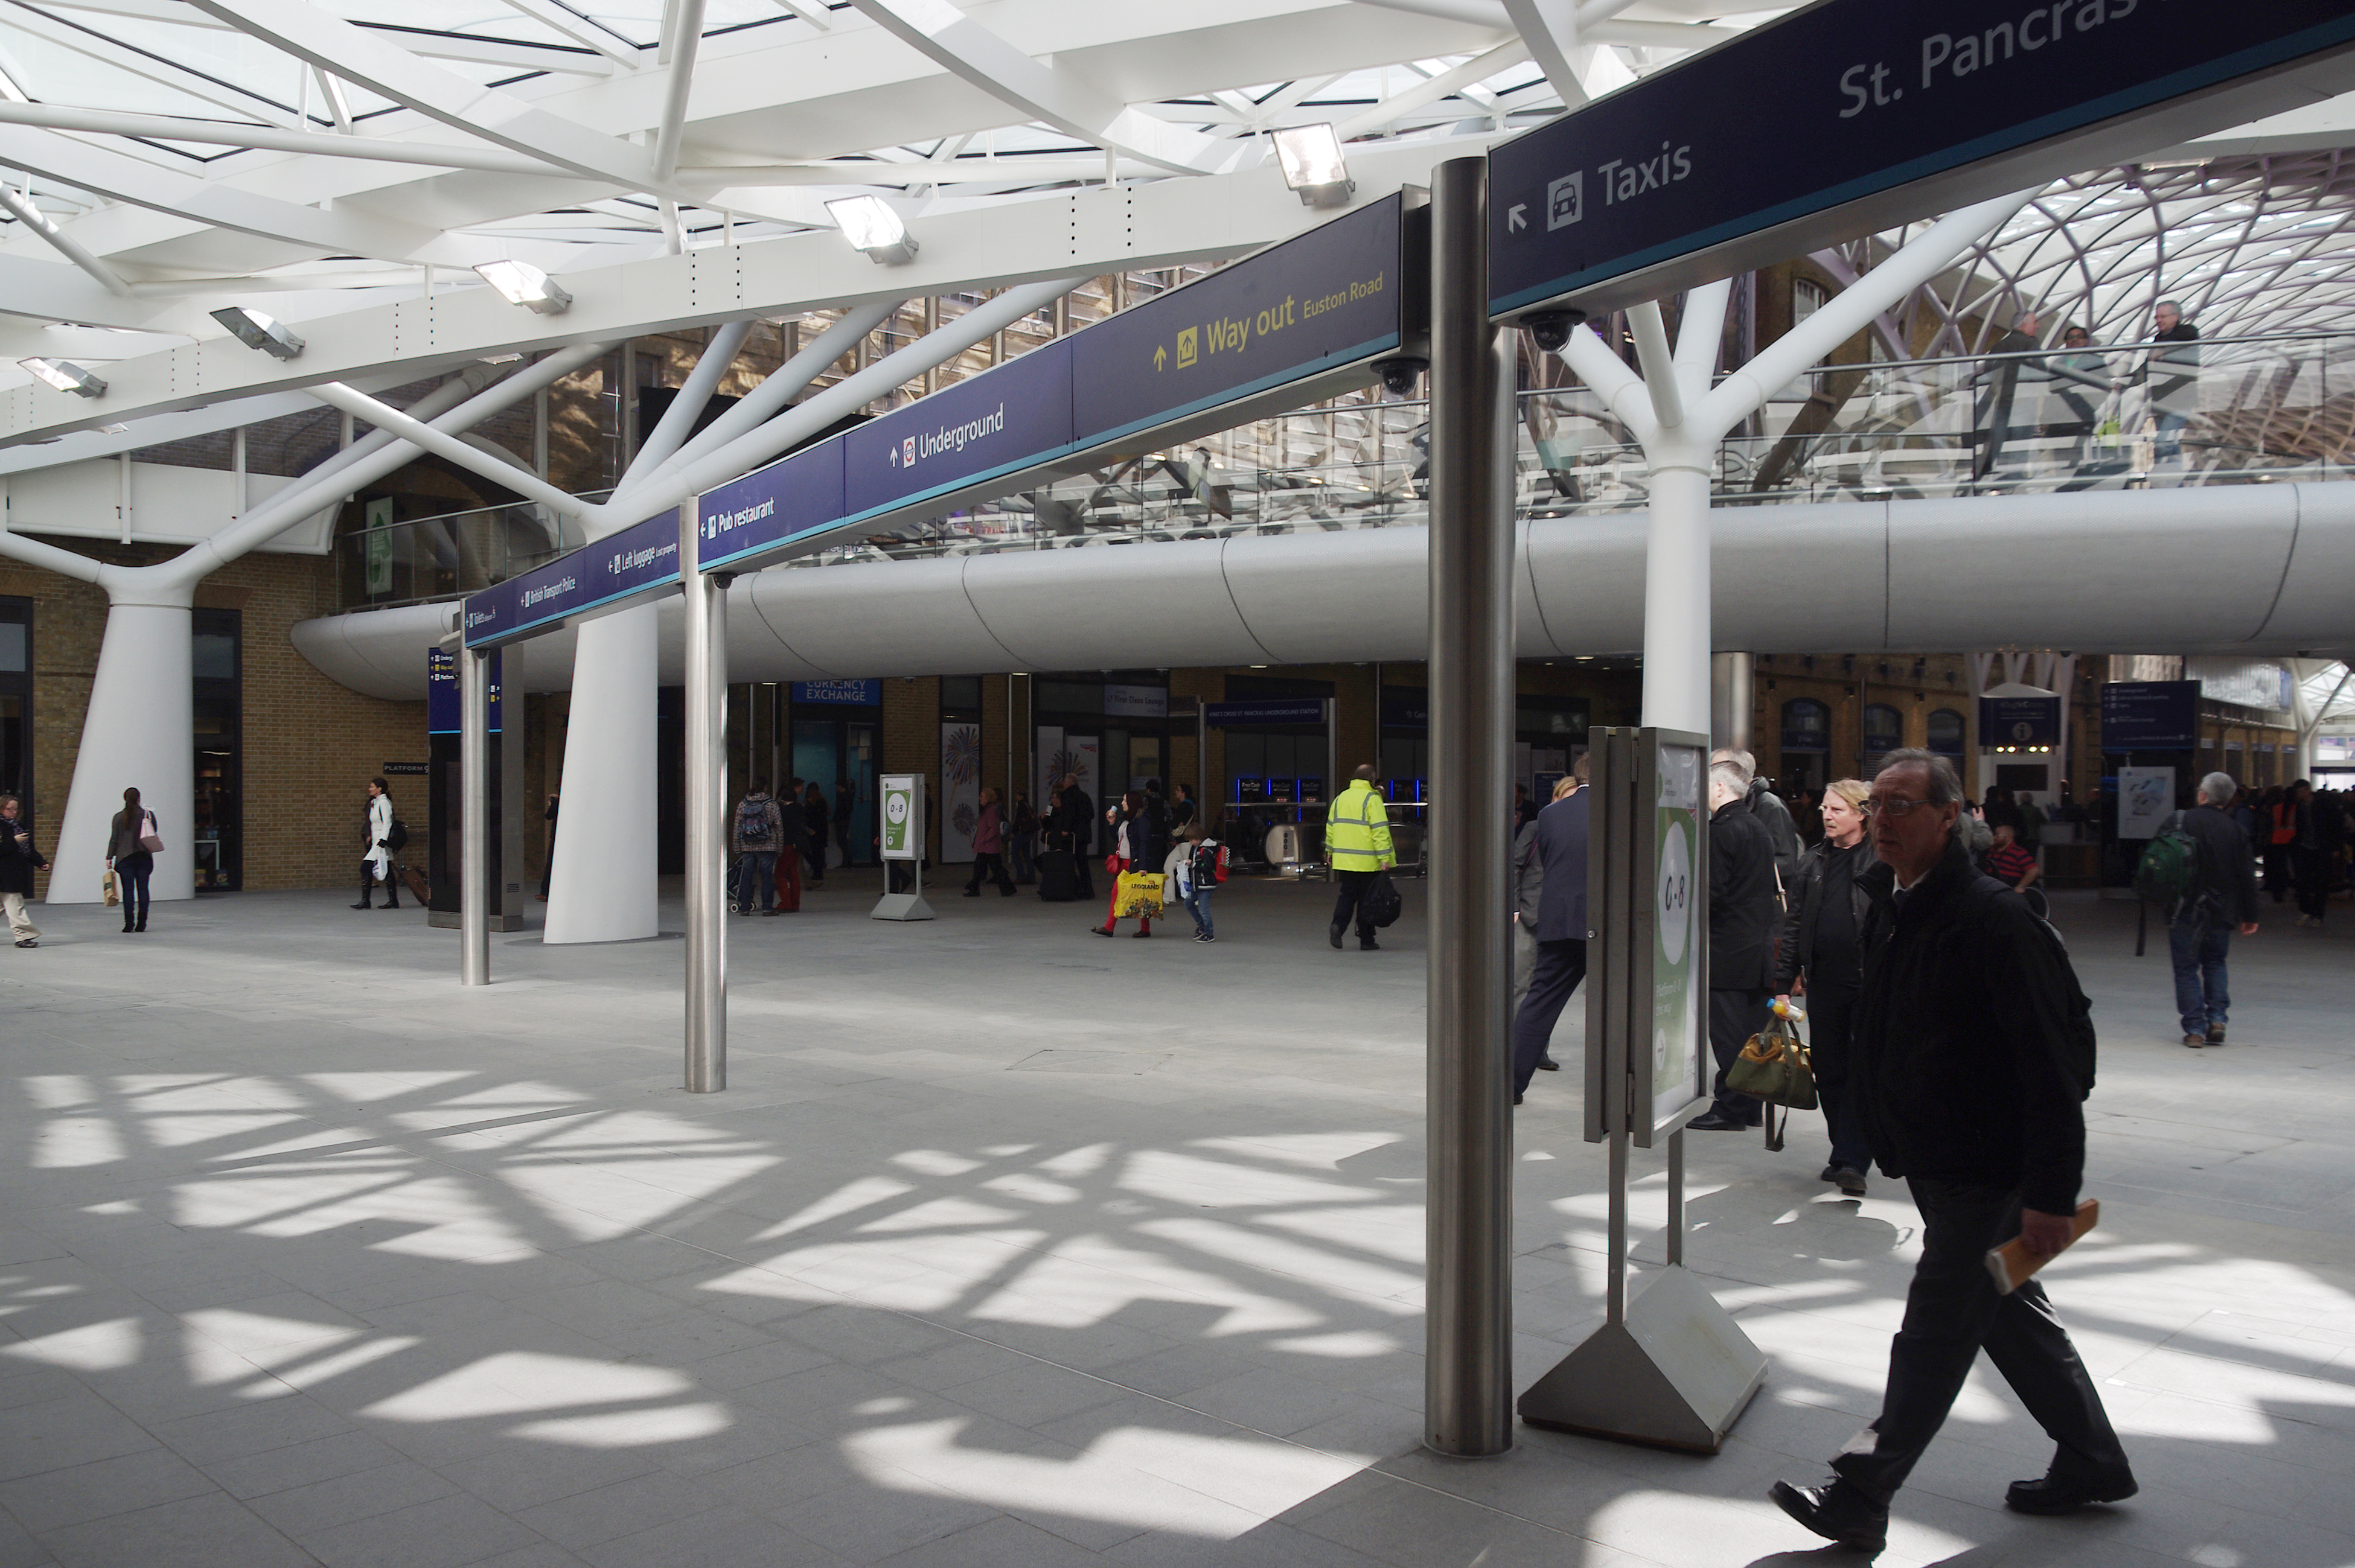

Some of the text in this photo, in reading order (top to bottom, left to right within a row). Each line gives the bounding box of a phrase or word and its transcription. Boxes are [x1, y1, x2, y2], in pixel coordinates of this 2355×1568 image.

[1838, 62, 1903, 118] St.
[1598, 140, 1691, 206] Taxis
[1207, 271, 1382, 355] Way out Euston Road
[919, 401, 1003, 459] Underground
[718, 496, 775, 534] Pub restaurant
[622, 551, 633, 571] Left
[633, 546, 656, 569] luggage
[531, 576, 576, 605] British Transport Police
[807, 689, 866, 701] EXCHANGE
